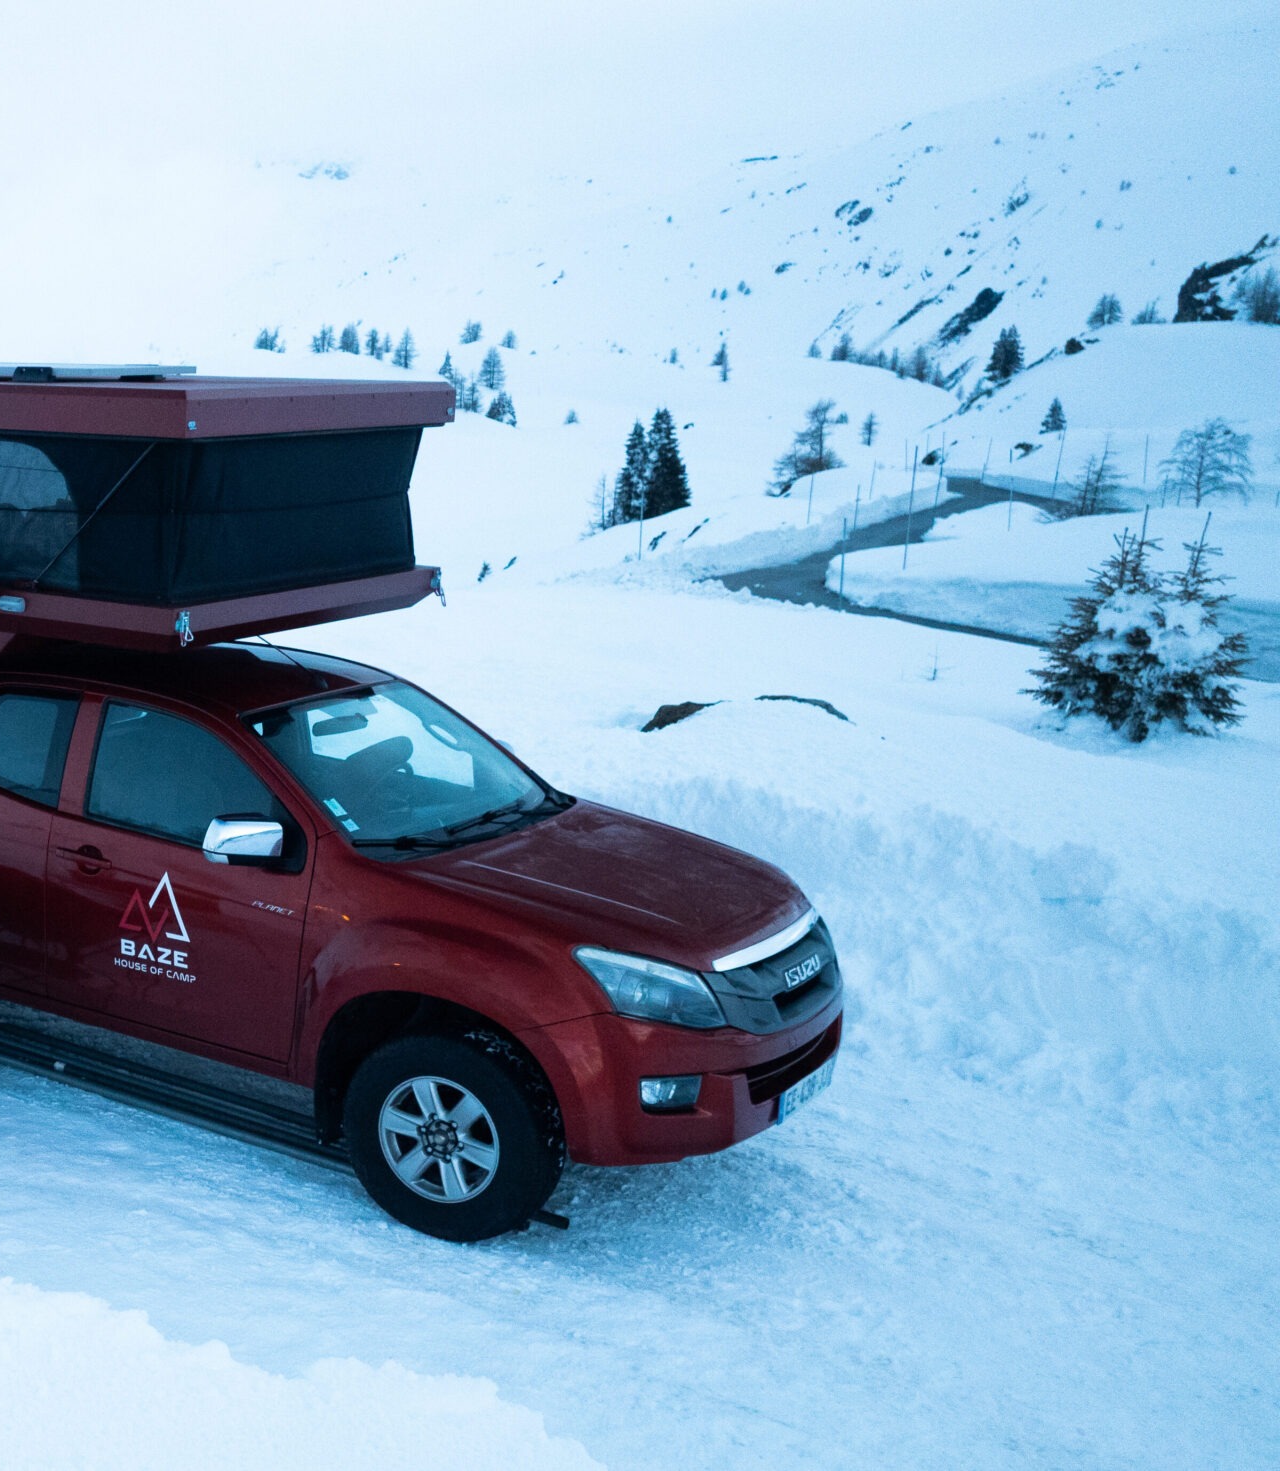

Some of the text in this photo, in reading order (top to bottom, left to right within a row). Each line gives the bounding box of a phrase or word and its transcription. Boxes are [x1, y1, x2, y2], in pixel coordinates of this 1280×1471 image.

[251, 900, 295, 917] PLANET
[120, 938, 189, 969] BAZE
[114, 957, 197, 984] HOUSE OF CAMP
[784, 953, 821, 988] ISUZU
